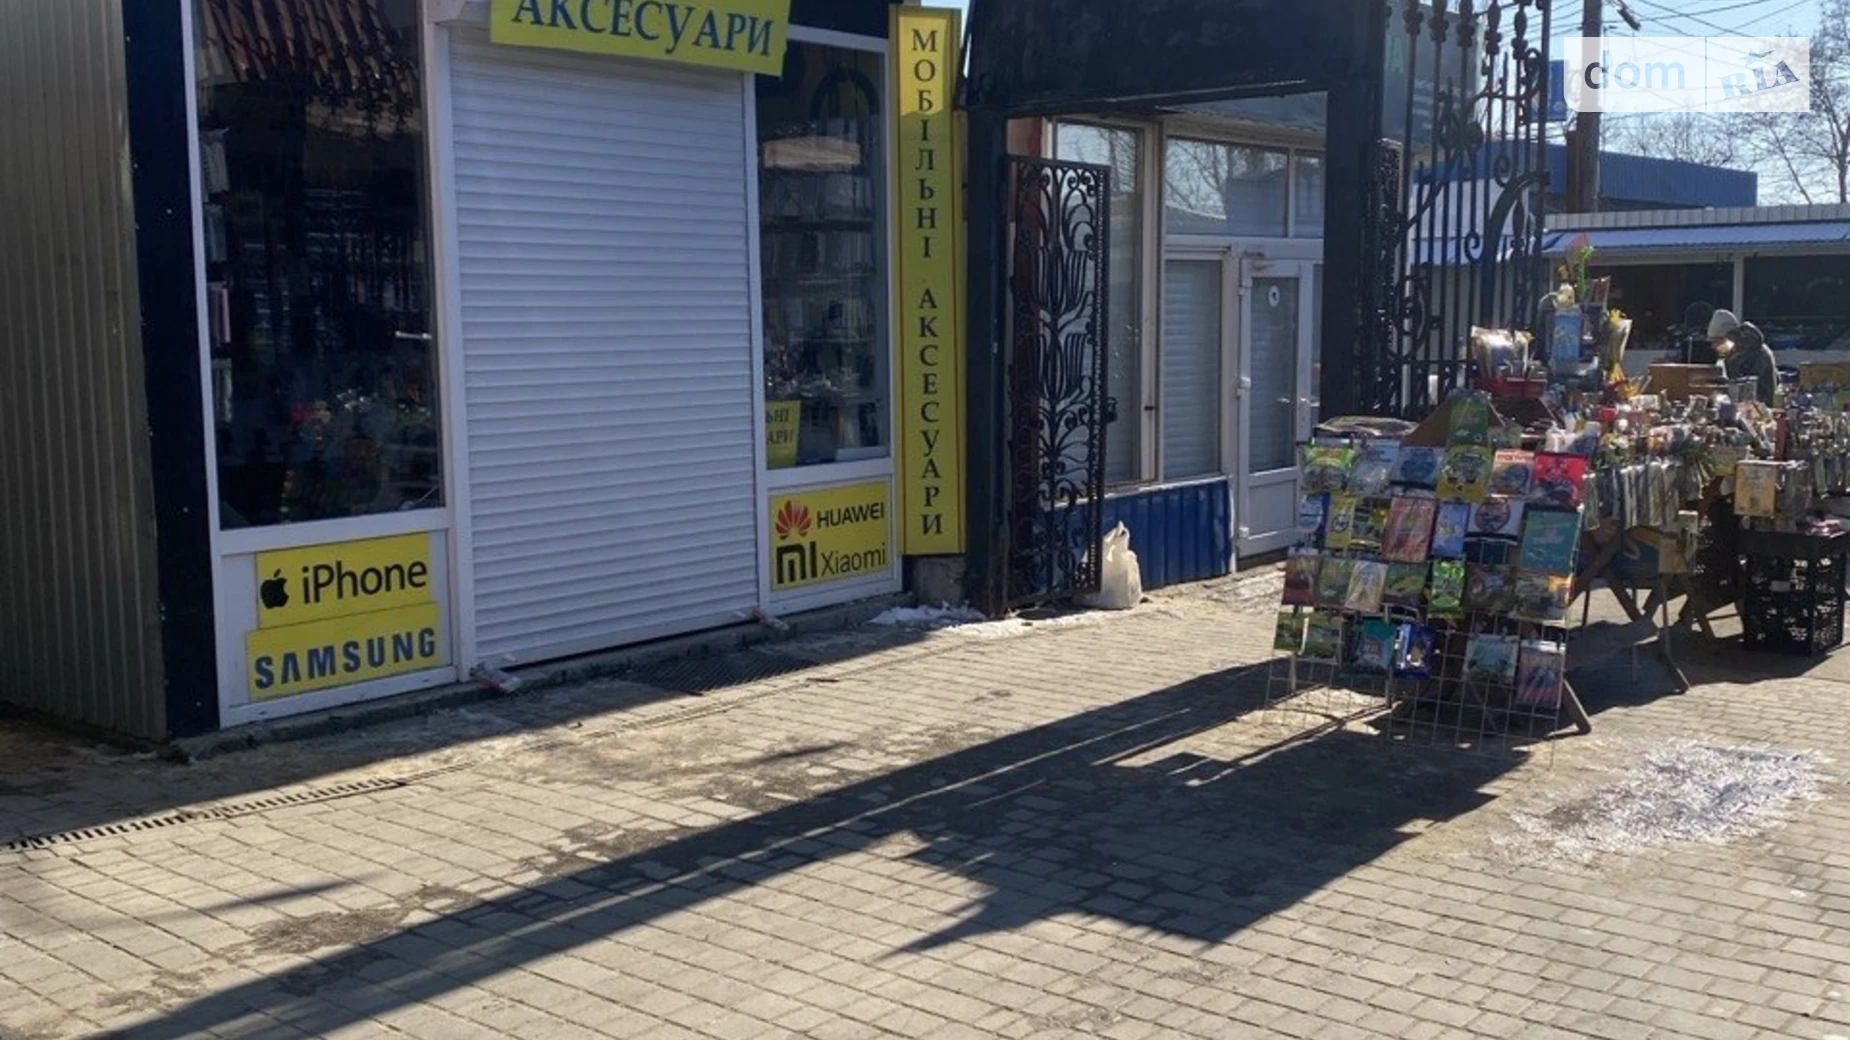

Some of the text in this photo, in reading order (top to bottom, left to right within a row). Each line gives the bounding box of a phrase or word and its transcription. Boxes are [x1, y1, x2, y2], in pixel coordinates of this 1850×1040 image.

[511, 0, 774, 56] АКСЕСУАРИ
[911, 28, 944, 535] МОБІЛЬНІ АКСЕСУАРИ
[816, 502, 885, 528] HUAWEI
[302, 560, 428, 605] iPhone
[821, 543, 886, 577] Xiaomi
[254, 627, 436, 690] SAMSUNG
